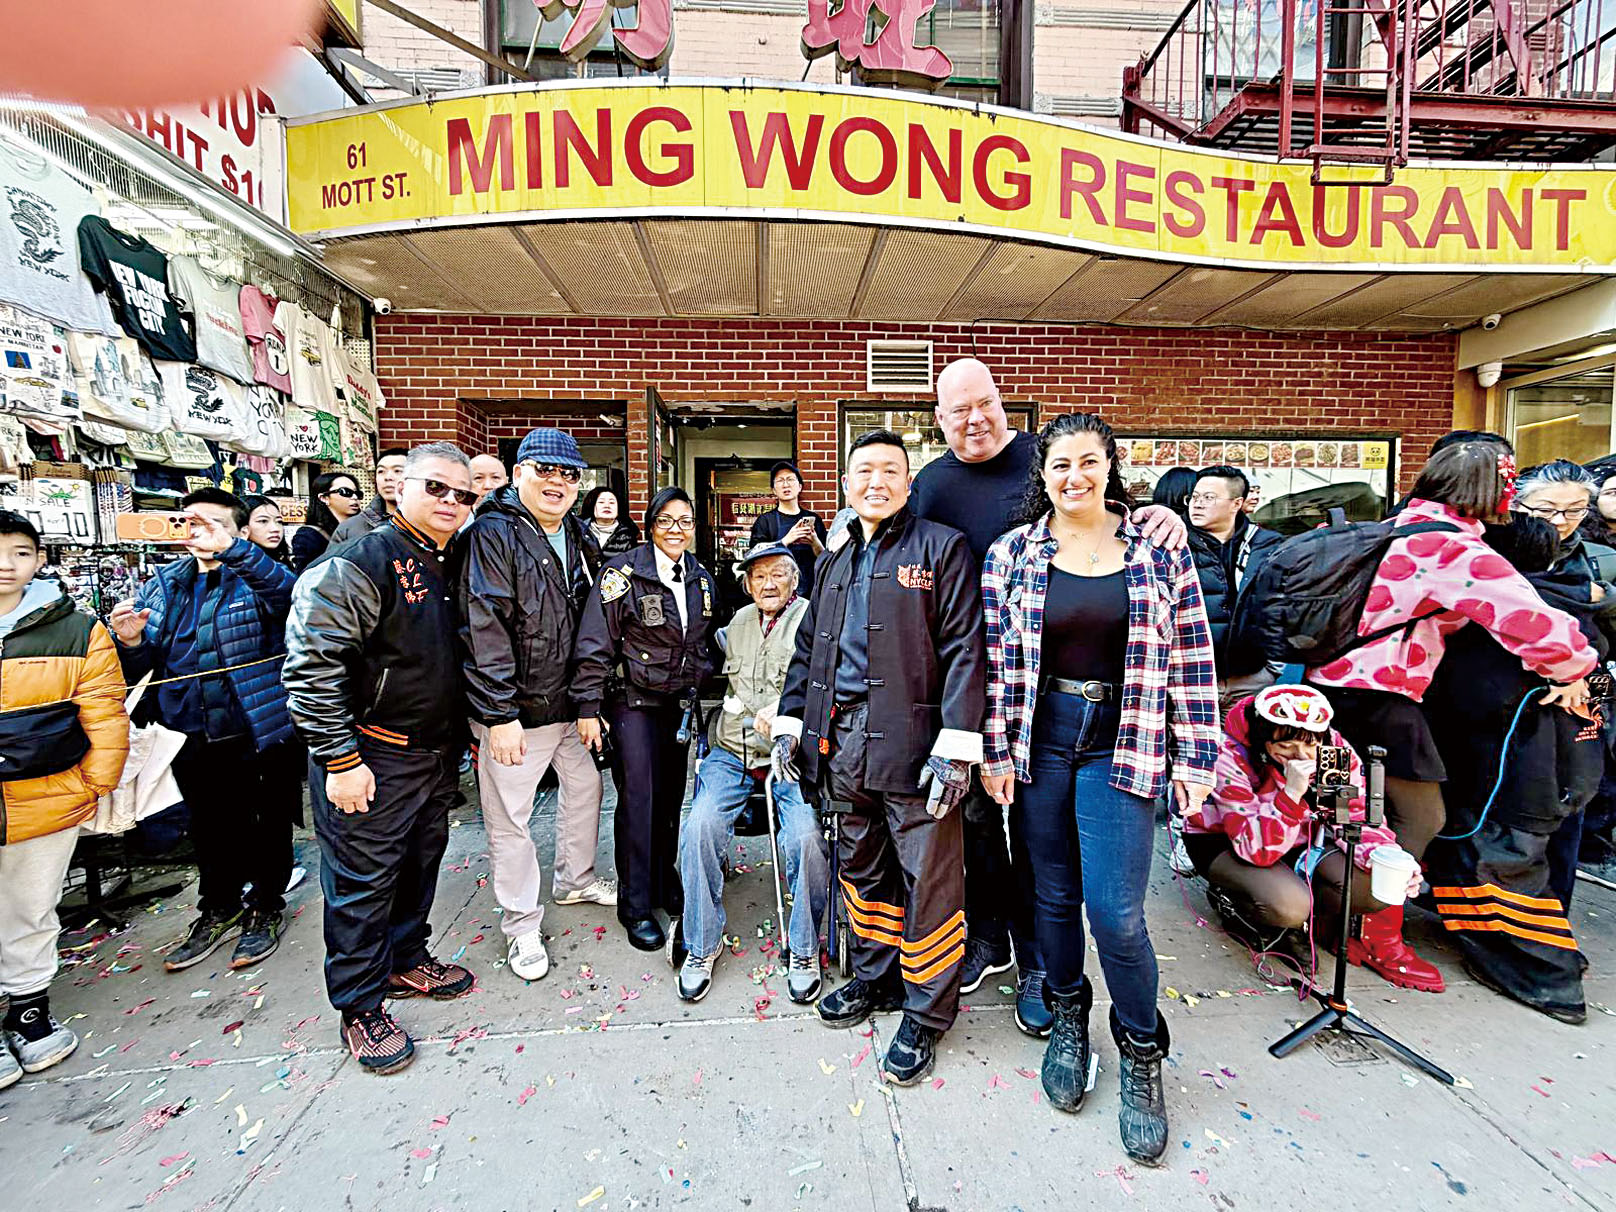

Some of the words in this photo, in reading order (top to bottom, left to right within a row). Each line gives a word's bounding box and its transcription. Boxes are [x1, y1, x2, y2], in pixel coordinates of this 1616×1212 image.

[346, 142, 367, 169] 61
[221, 153, 264, 206] $1
[321, 177, 376, 209] MOTT
[382, 172, 411, 200] ST.
[446, 106, 695, 196] MING
[728, 110, 1032, 211] WONG
[1059, 146, 1588, 251] RESTAURANT
[290, 433, 318, 444] NEW
[290, 441, 320, 453] YORK
[39, 496, 72, 508] SALE
